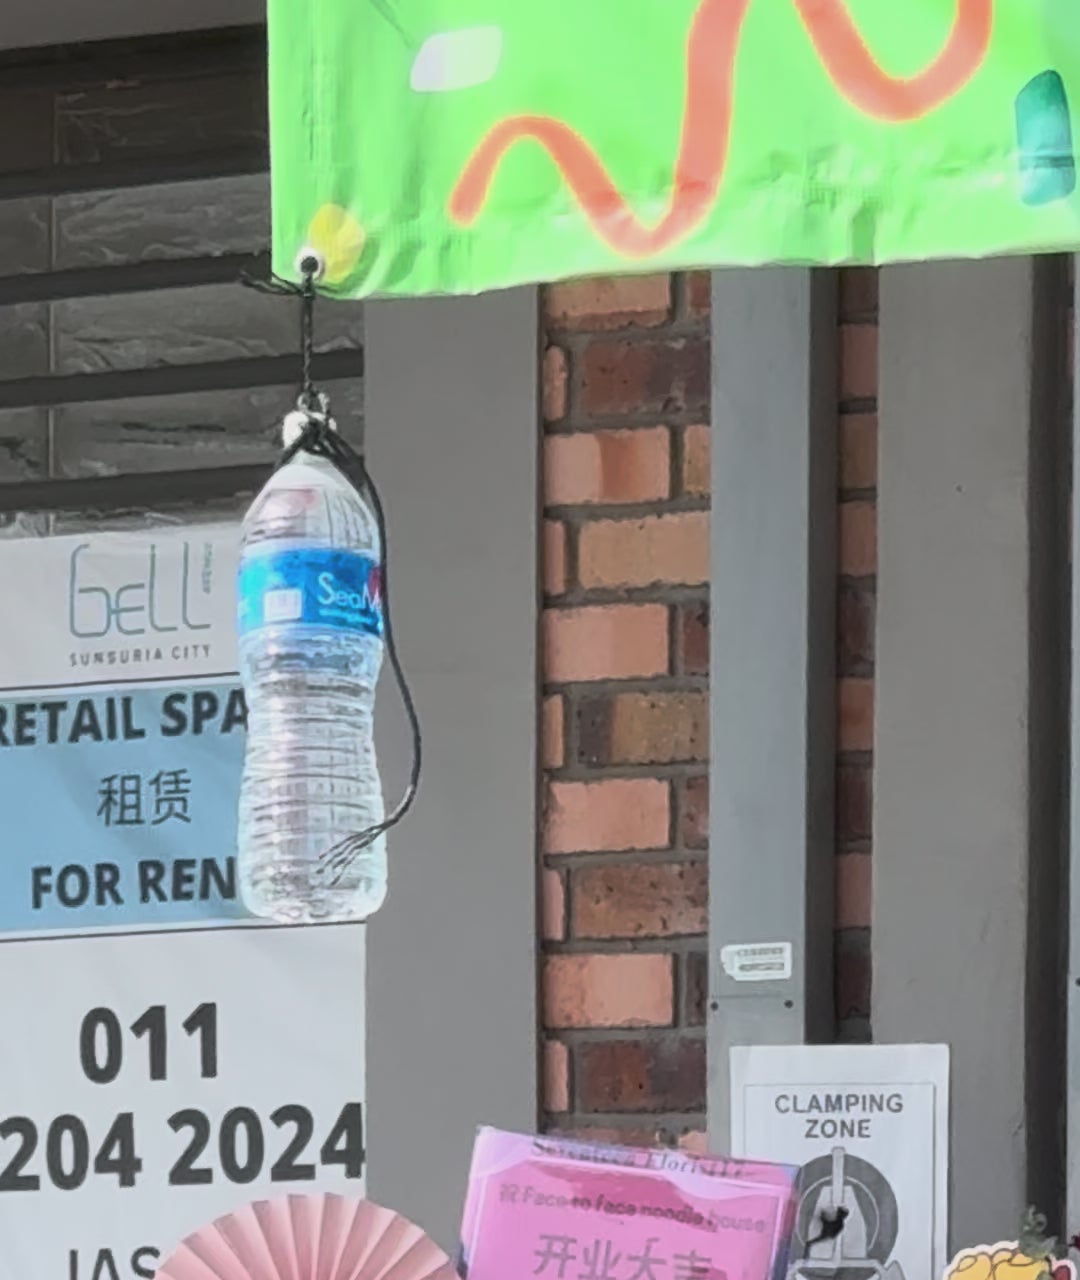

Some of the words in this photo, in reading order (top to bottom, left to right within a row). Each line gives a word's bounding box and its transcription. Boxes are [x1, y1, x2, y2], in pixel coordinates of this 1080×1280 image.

[69, 647, 163, 667] SUNSURIA
[170, 644, 211, 660] CITY
[97, 768, 193, 827] 租赁
[31, 861, 125, 909] FOR
[79, 1002, 218, 1084] 011
[775, 1093, 904, 1114] CLAMPING
[0, 1112, 142, 1191] 204
[167, 1102, 366, 1185] 2024
[804, 1119, 872, 1139] ZONE
[522, 1186, 566, 1208] Face
[571, 1191, 592, 1209] to
[596, 1194, 637, 1217] face
[640, 1199, 705, 1226] noodle
[708, 1207, 766, 1233] house
